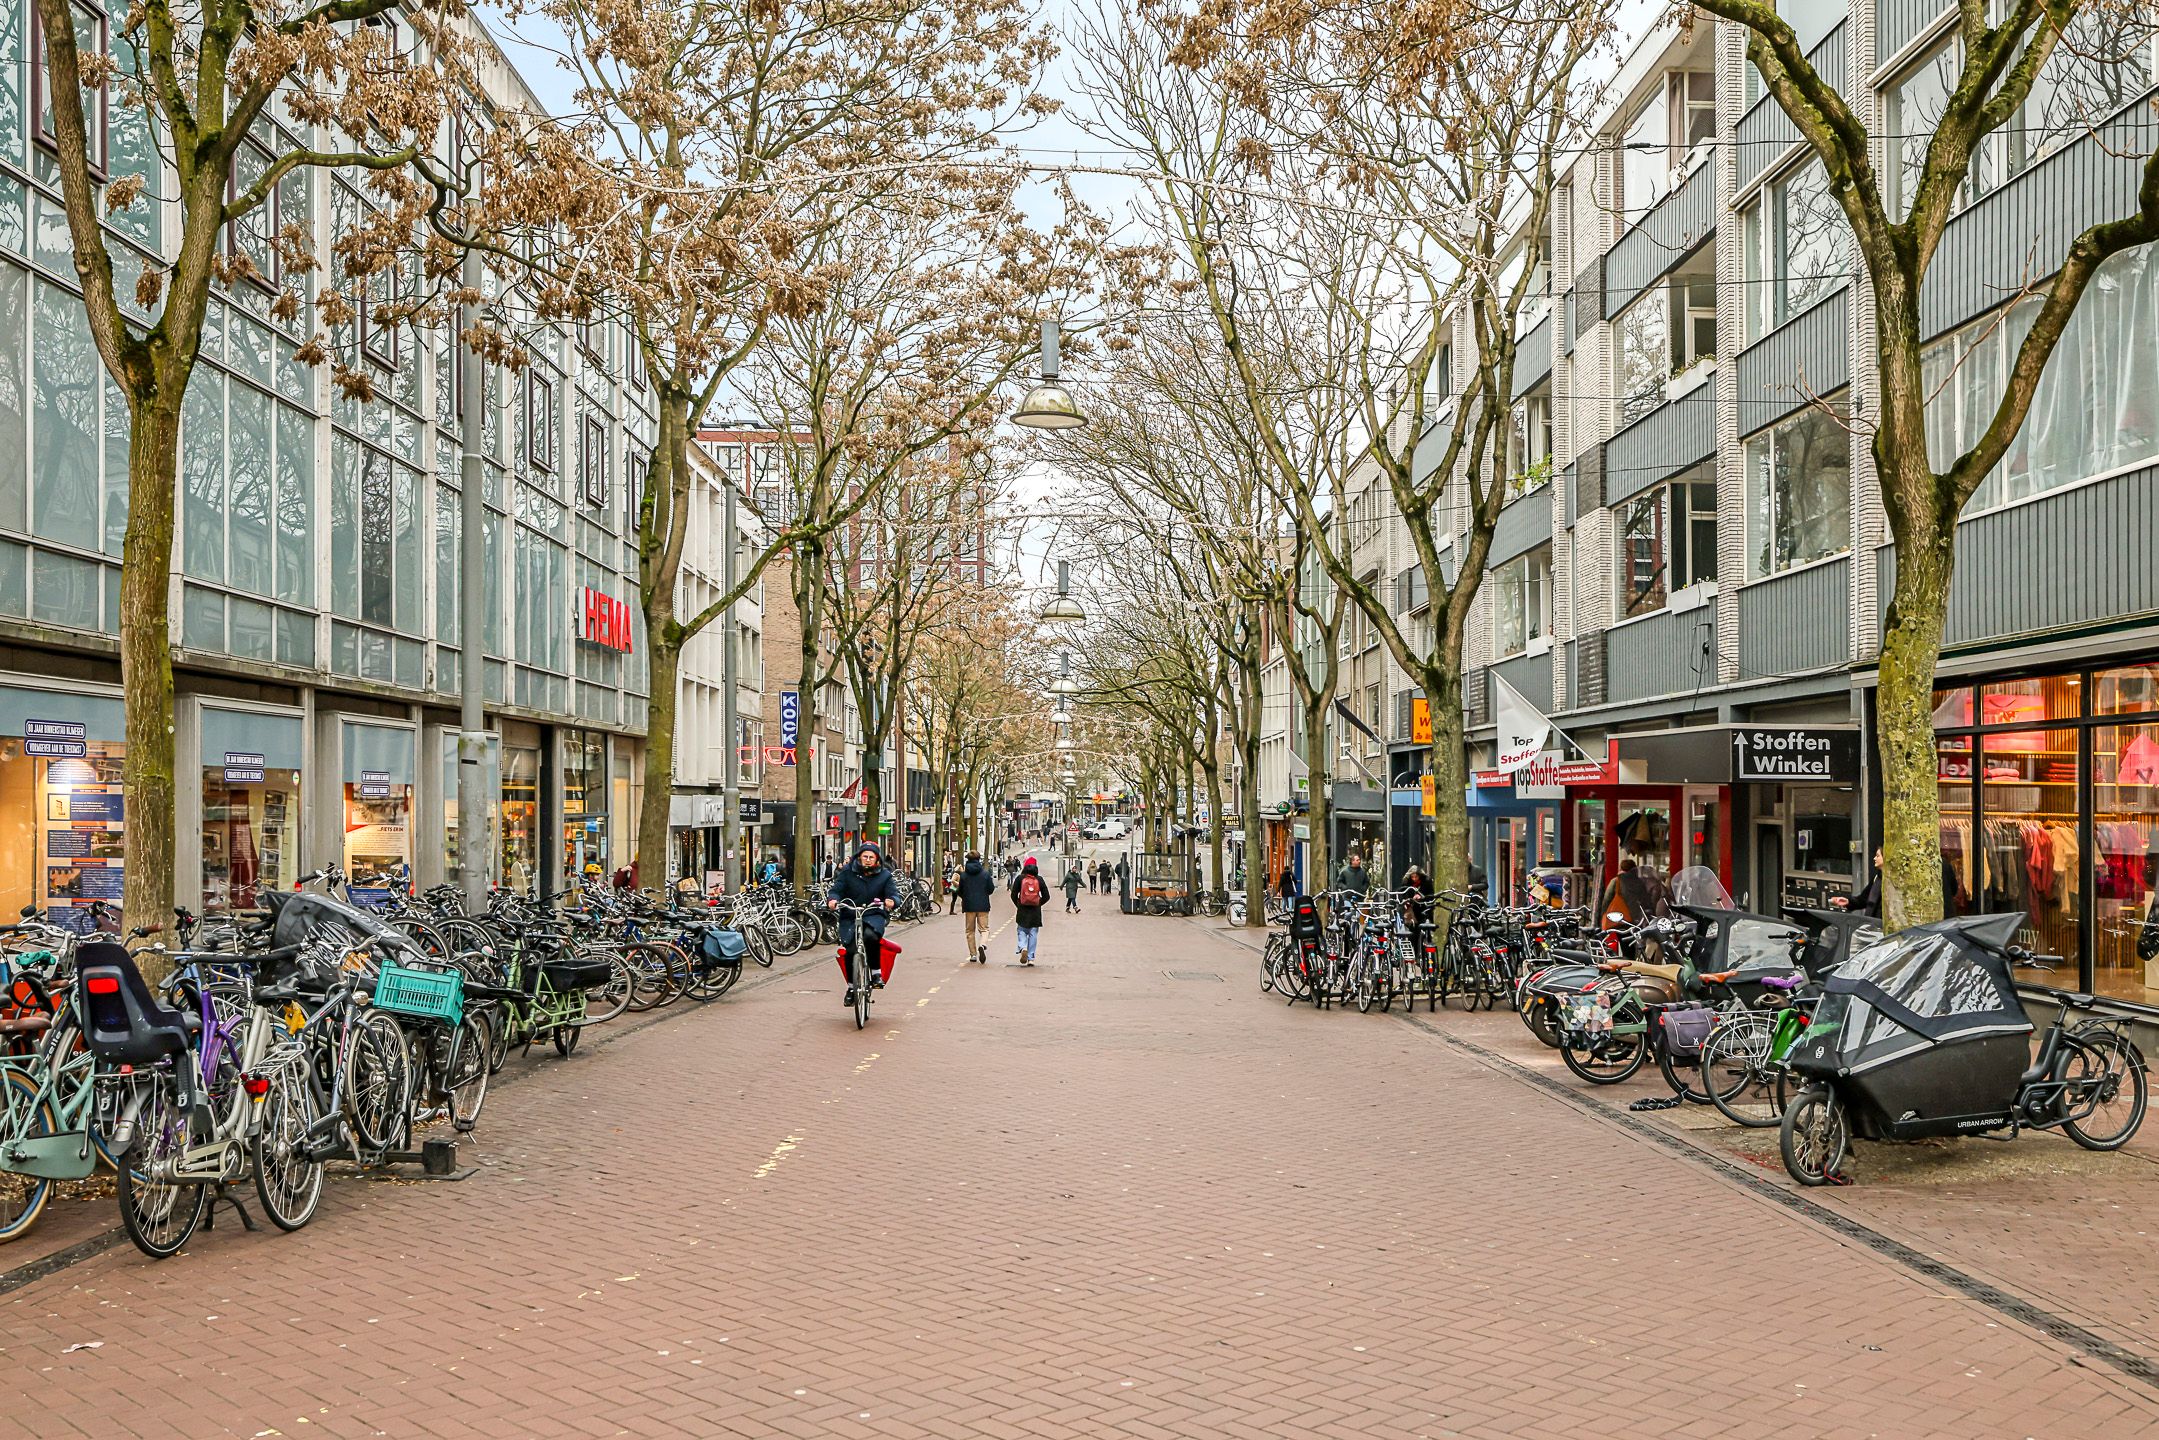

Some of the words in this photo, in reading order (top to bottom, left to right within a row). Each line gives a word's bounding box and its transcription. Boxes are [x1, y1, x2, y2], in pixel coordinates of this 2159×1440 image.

[585, 585, 633, 655] HEMA
[782, 695, 797, 744] KOCK
[1512, 736, 1534, 746] Top
[1752, 731, 1831, 751] Stoffen
[1516, 756, 1559, 794] TopStoffe
[1752, 755, 1830, 774] Winkel
[2018, 928, 2040, 951] my
[43, 1030, 62, 1063] zelle
[1957, 1120, 1980, 1128] URBAN
[1980, 1118, 2004, 1126] ARROW
